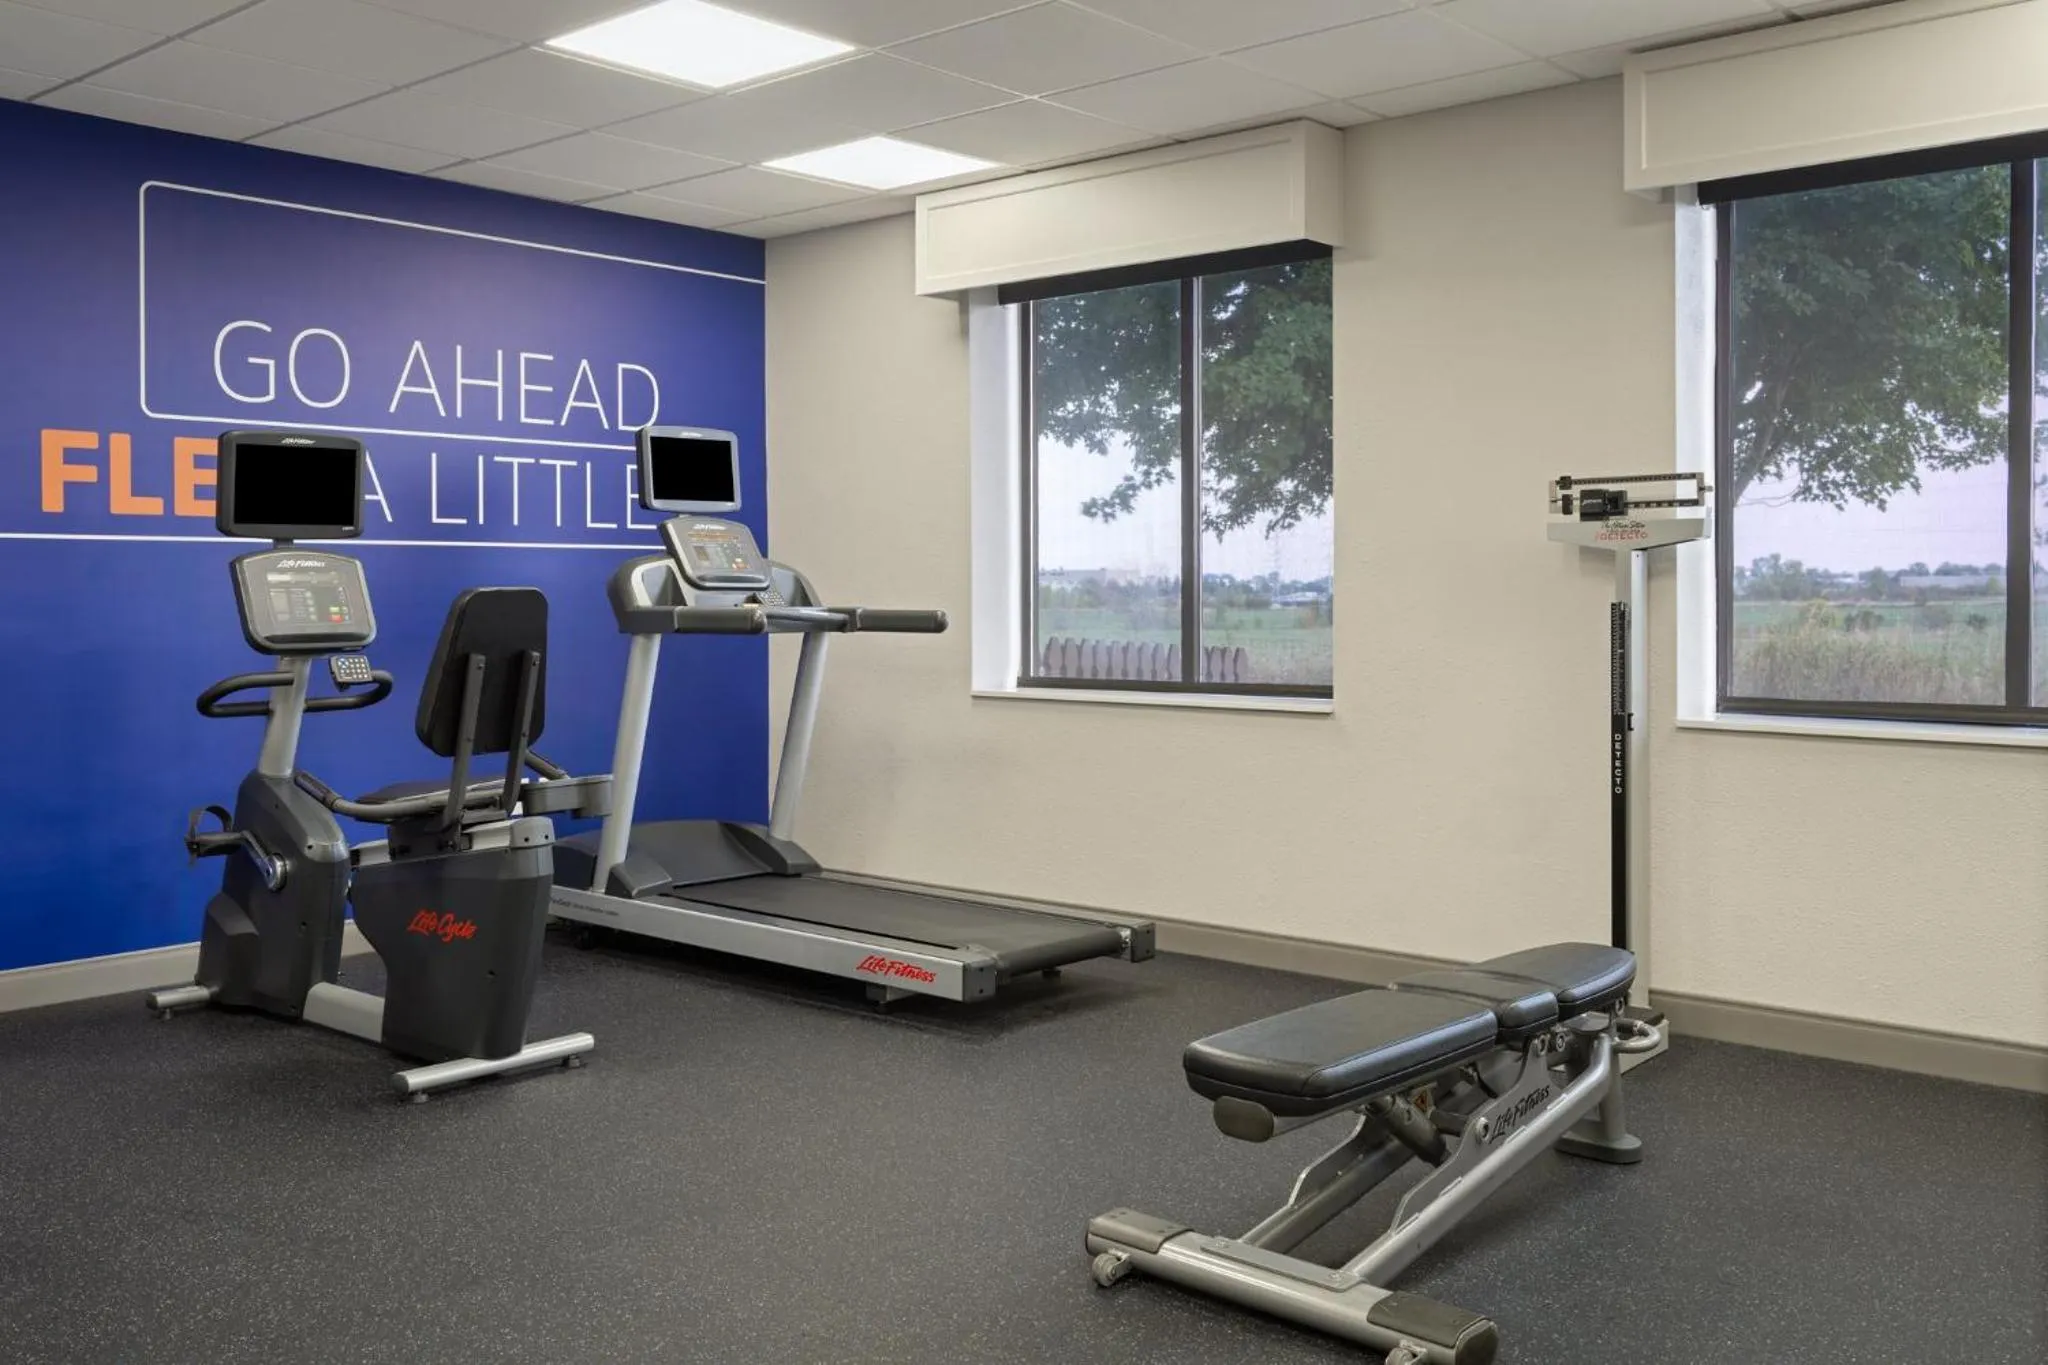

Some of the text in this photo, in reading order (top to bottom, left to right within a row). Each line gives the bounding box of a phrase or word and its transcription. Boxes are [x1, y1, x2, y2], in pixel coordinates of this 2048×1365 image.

[213, 320, 661, 431] GO AHEAD
[40, 429, 217, 516] FLE
[430, 452, 658, 531] LITTLE
[1614, 732, 1623, 794] DETECTO
